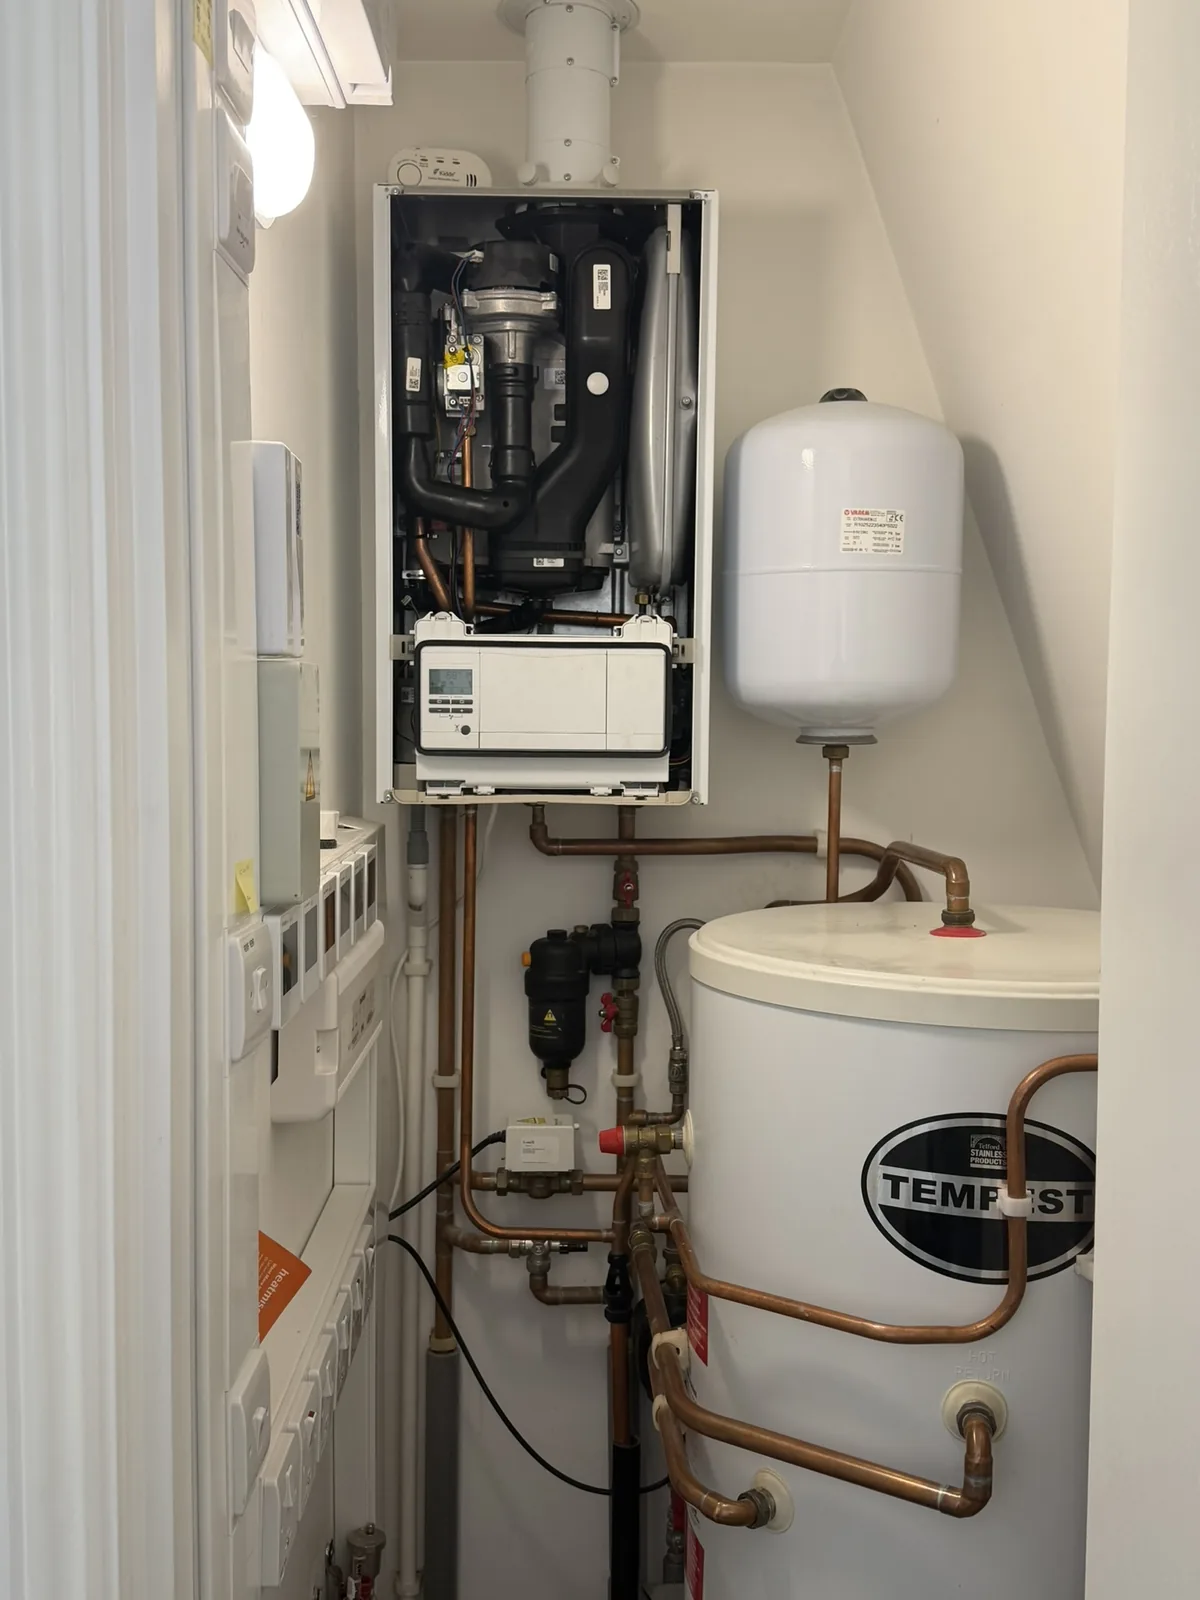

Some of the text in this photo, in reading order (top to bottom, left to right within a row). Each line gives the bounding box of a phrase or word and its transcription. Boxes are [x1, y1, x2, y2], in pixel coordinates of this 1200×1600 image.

[979, 1142, 1000, 1150] Telford
[882, 1172, 1093, 1215] TEMPST
[258, 1268, 290, 1312] heatmis
[968, 1349, 997, 1363] HOT
